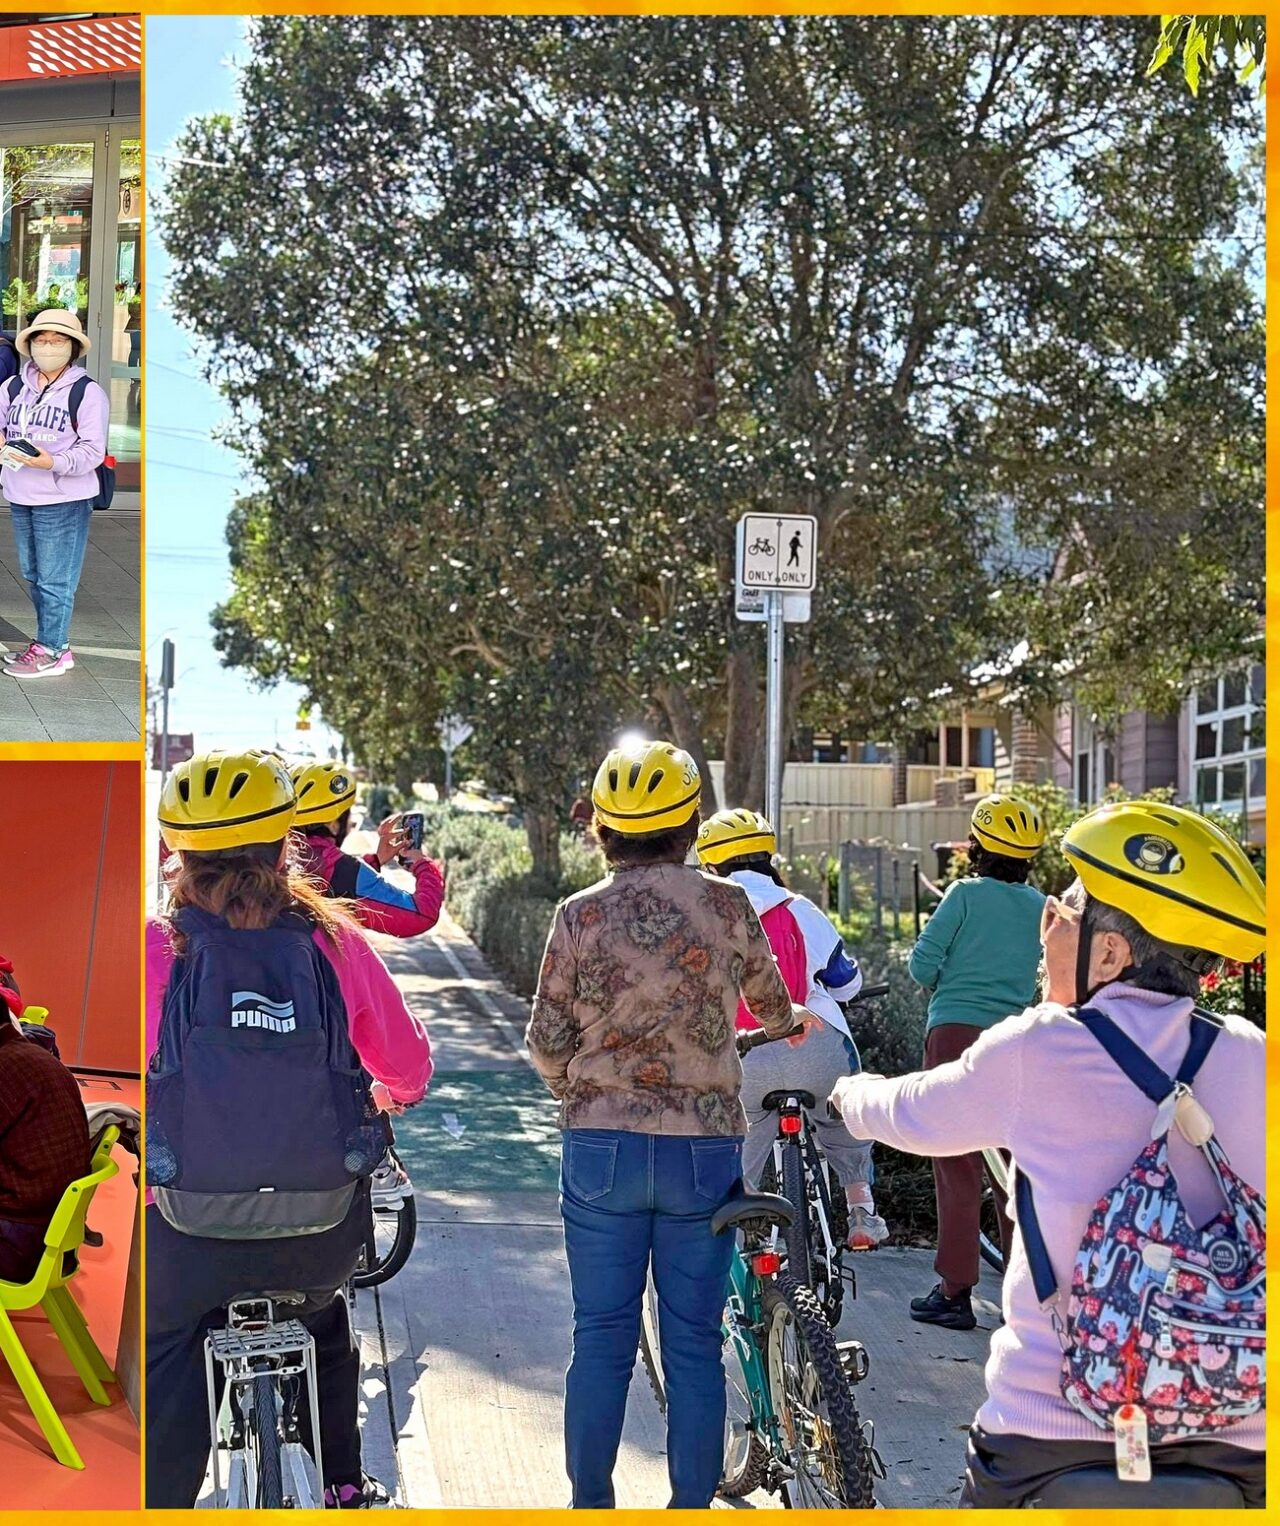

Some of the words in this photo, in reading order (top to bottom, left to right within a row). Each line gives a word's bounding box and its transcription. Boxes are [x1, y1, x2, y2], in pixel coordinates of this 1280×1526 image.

[748, 570, 774, 581] ONLY
[781, 571, 807, 583] ONLY
[976, 808, 993, 825] ofo
[231, 1010, 296, 1033] PUMA
